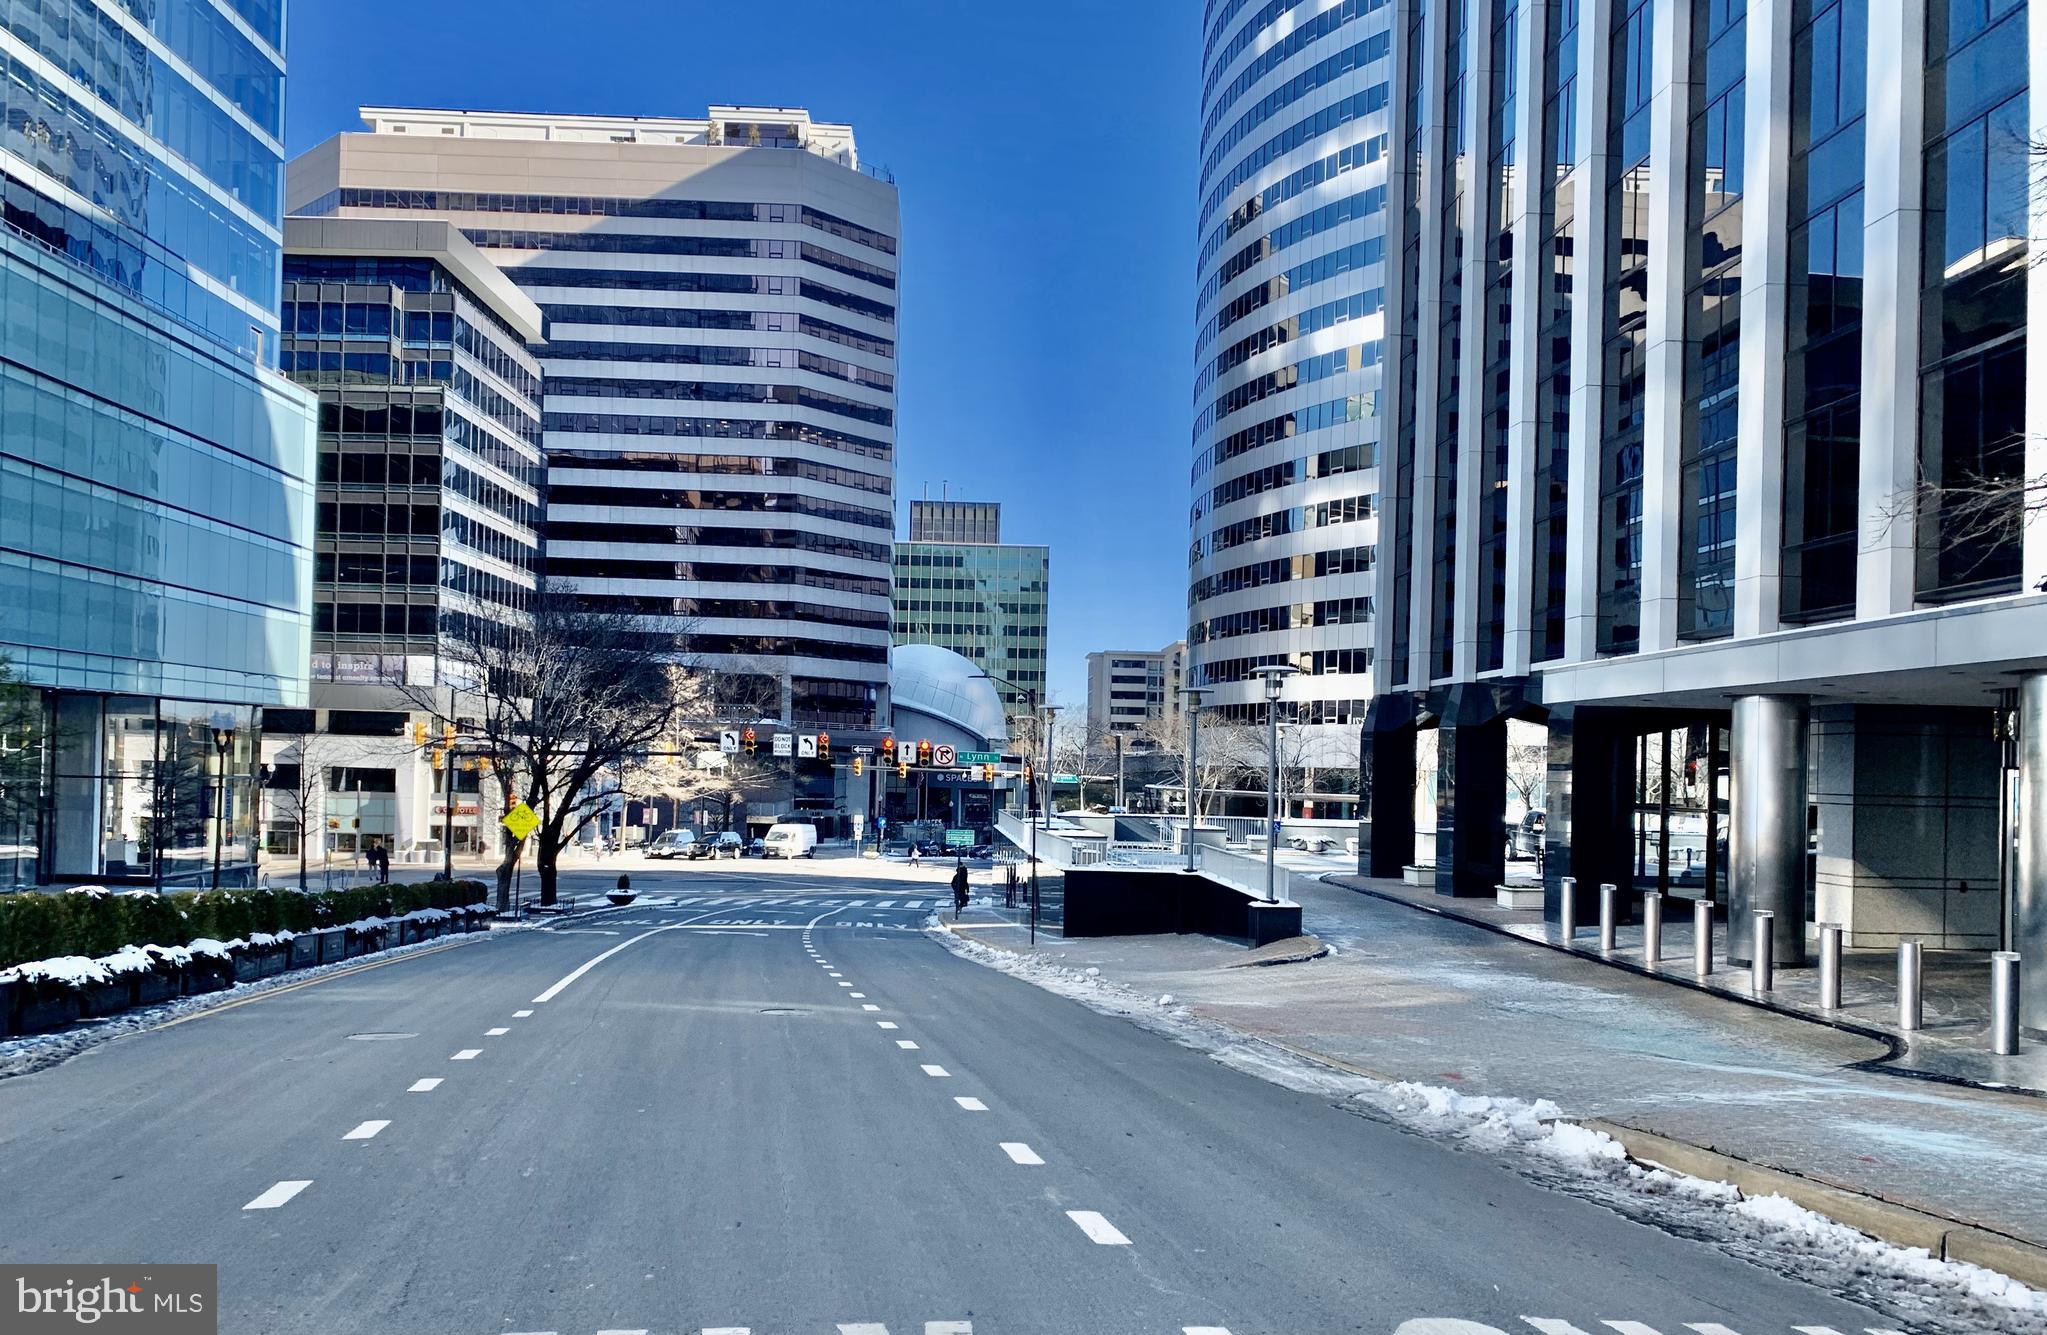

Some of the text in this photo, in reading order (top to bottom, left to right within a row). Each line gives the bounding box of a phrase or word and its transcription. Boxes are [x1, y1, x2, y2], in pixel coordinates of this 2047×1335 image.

[322, 661, 331, 669] to
[966, 752, 990, 762] Lynn
[835, 921, 907, 929] ONLY
